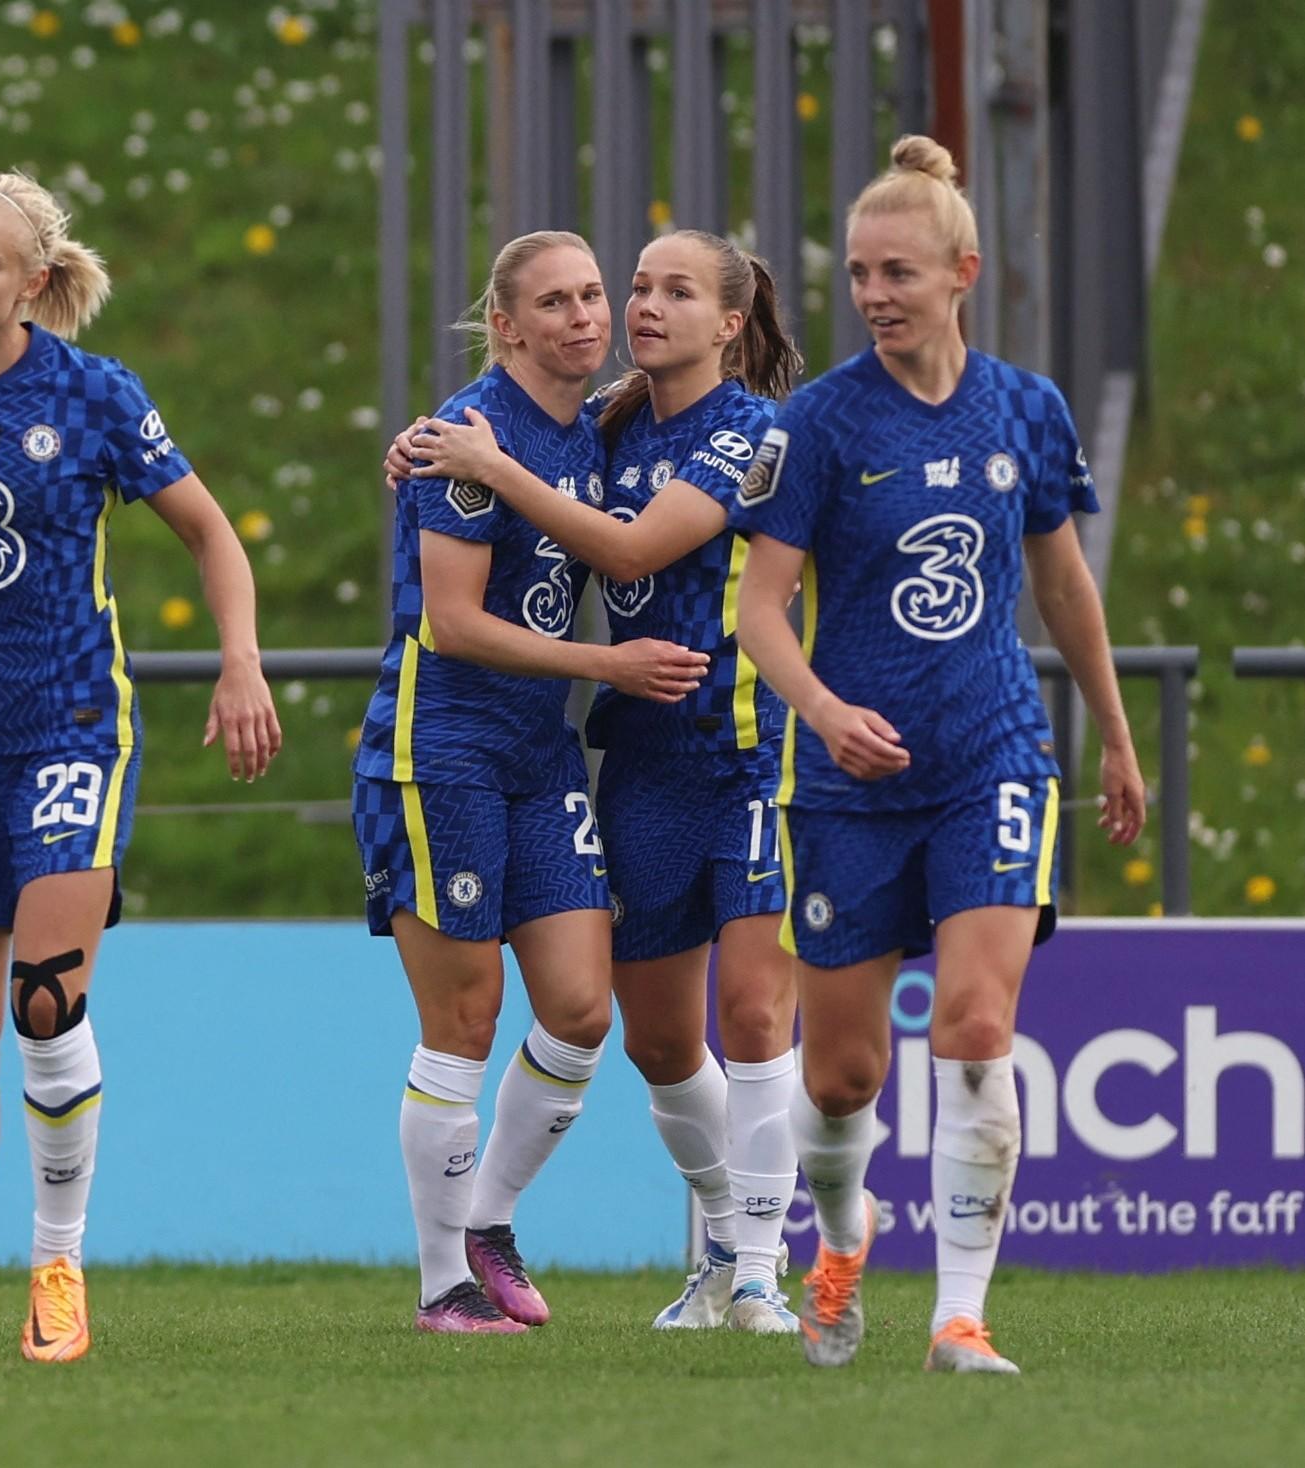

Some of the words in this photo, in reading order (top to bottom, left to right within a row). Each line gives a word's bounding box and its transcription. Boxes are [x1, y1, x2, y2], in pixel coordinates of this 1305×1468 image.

[891, 513, 985, 641] 3
[32, 762, 102, 828] 23
[564, 791, 604, 856] 2
[997, 783, 1030, 852] 5
[746, 1196, 782, 1207] CFC
[1114, 1190, 1197, 1236] the
[1208, 1189, 1305, 1236] faff
